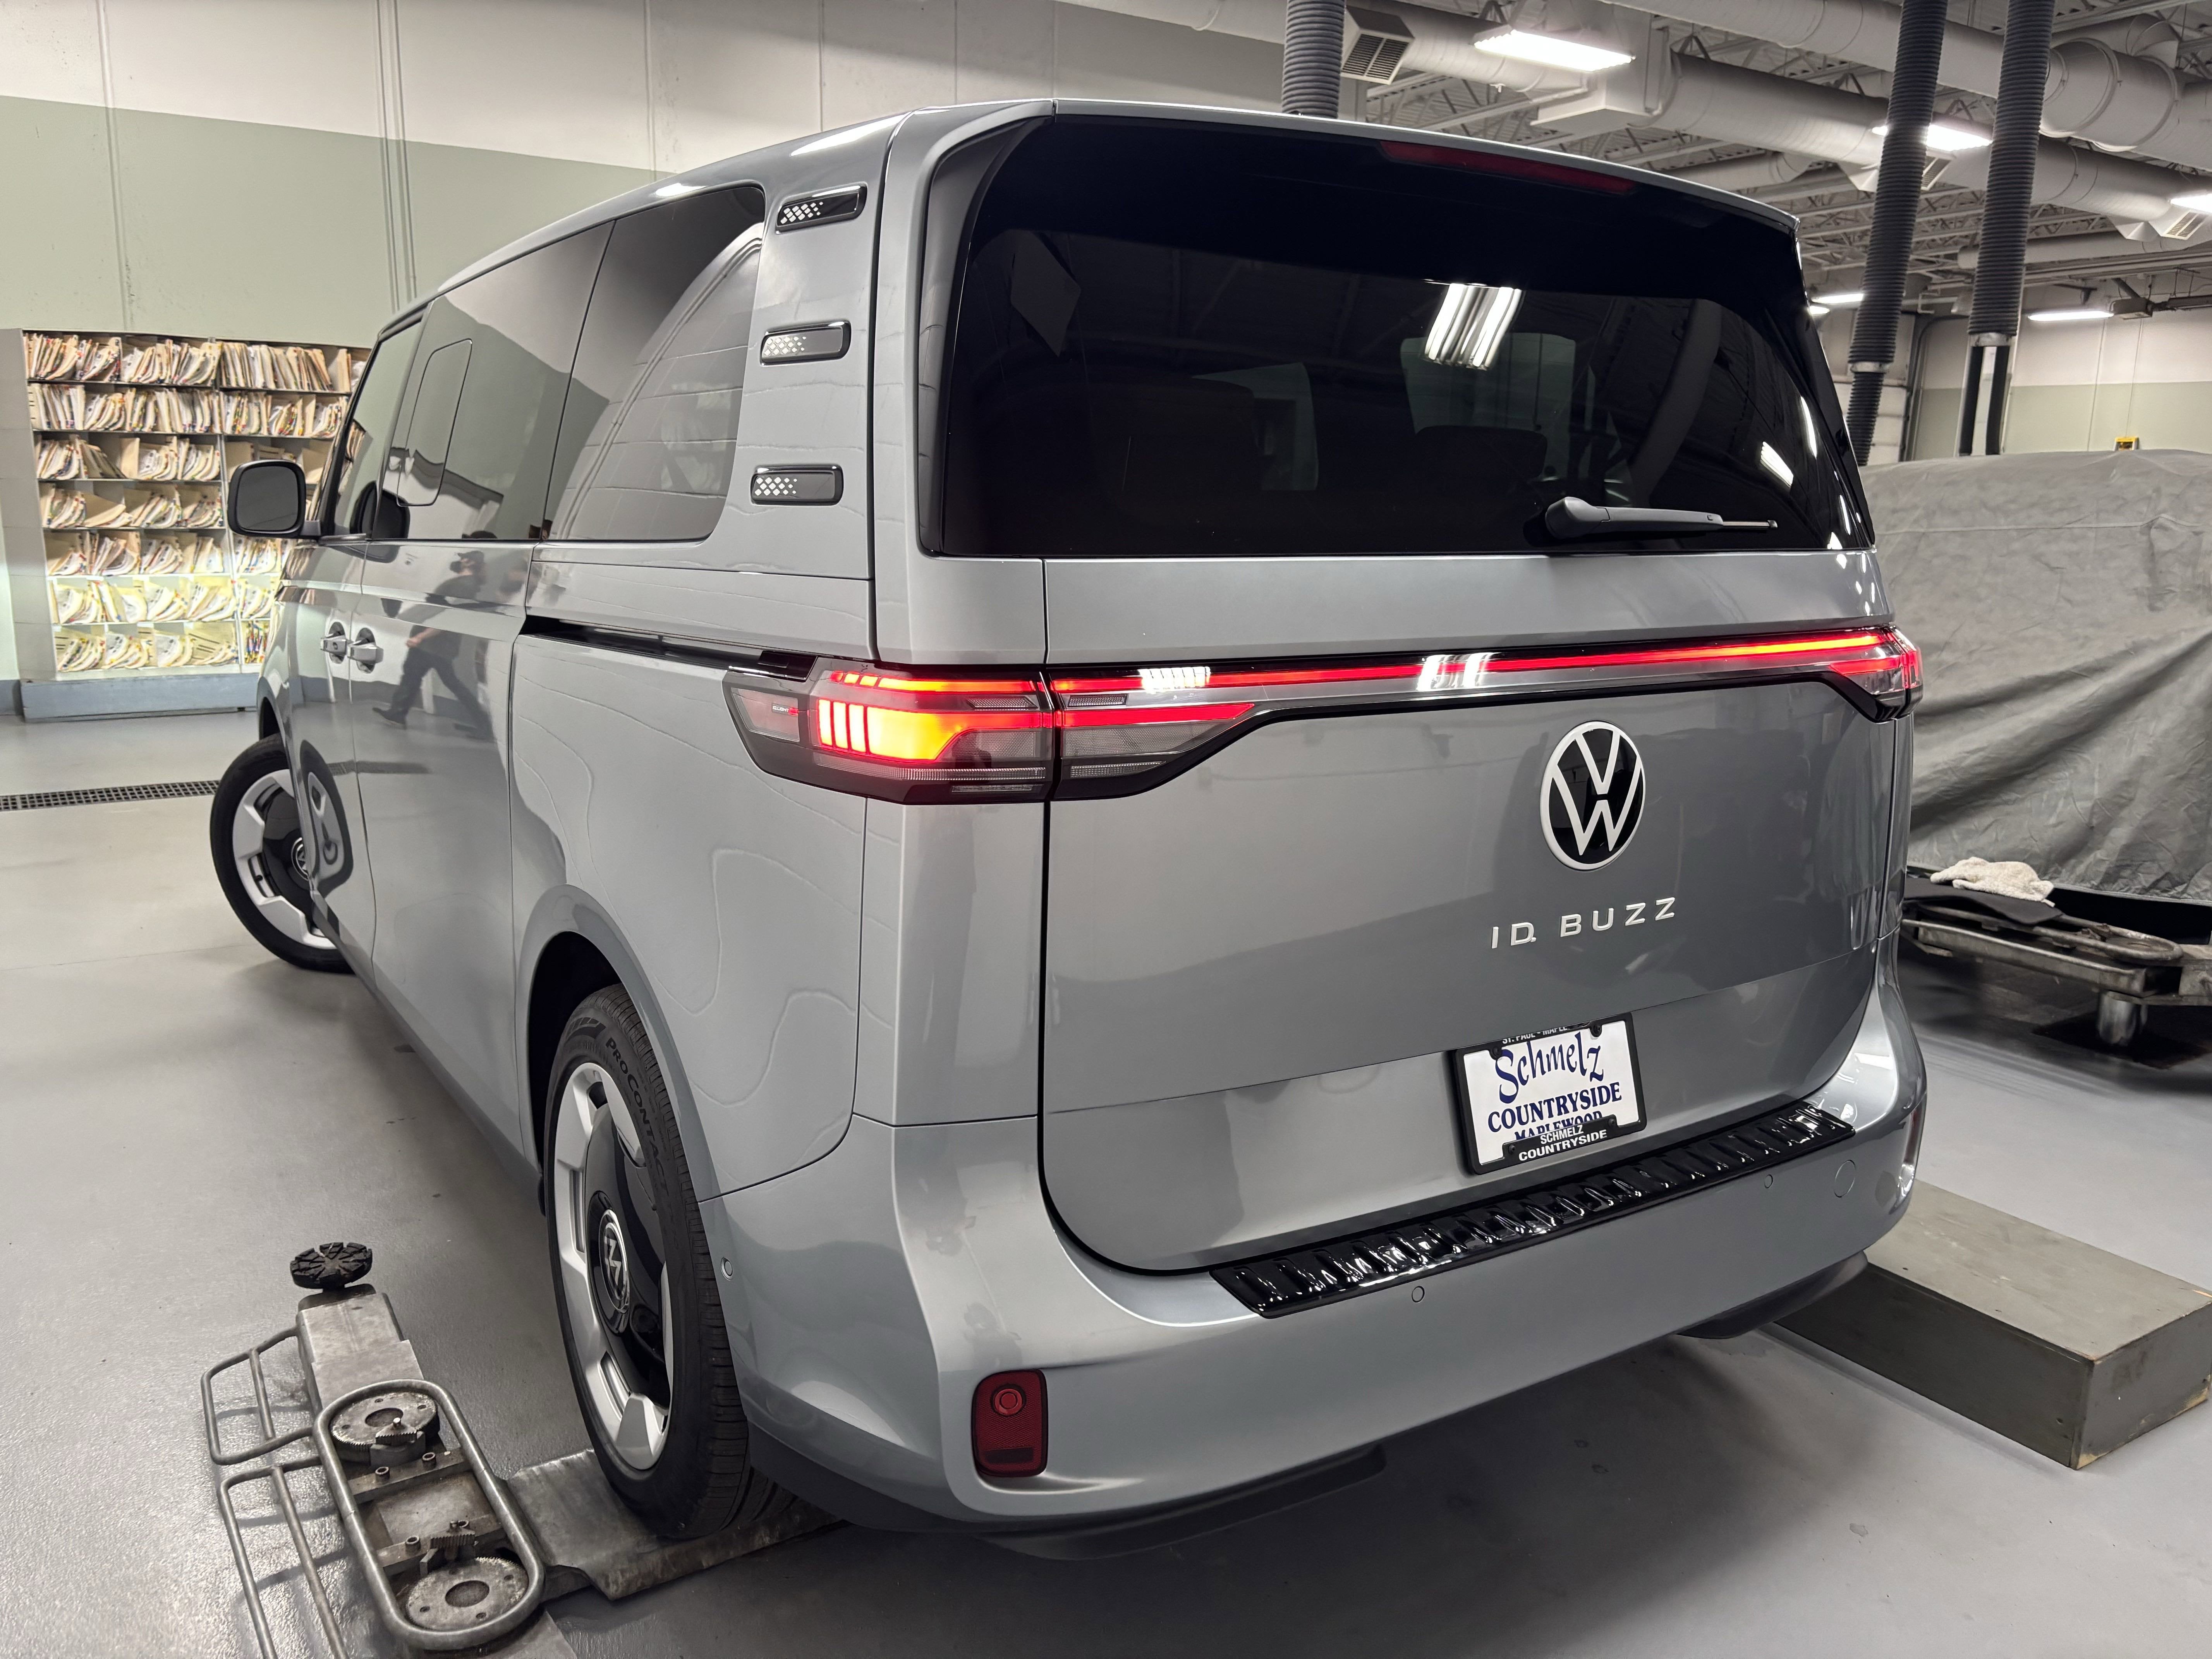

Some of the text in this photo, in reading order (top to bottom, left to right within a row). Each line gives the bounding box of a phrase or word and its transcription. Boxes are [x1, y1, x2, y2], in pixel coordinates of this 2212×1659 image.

[1560, 897, 1675, 937] BUZZ
[1495, 1032, 1604, 1104] Schmelz
[1488, 1082, 1622, 1133] COUNTRYSIDE
[1518, 1129, 1607, 1161] COUNTRYSIDE
[1540, 1125, 1584, 1145] SCHMELZ
